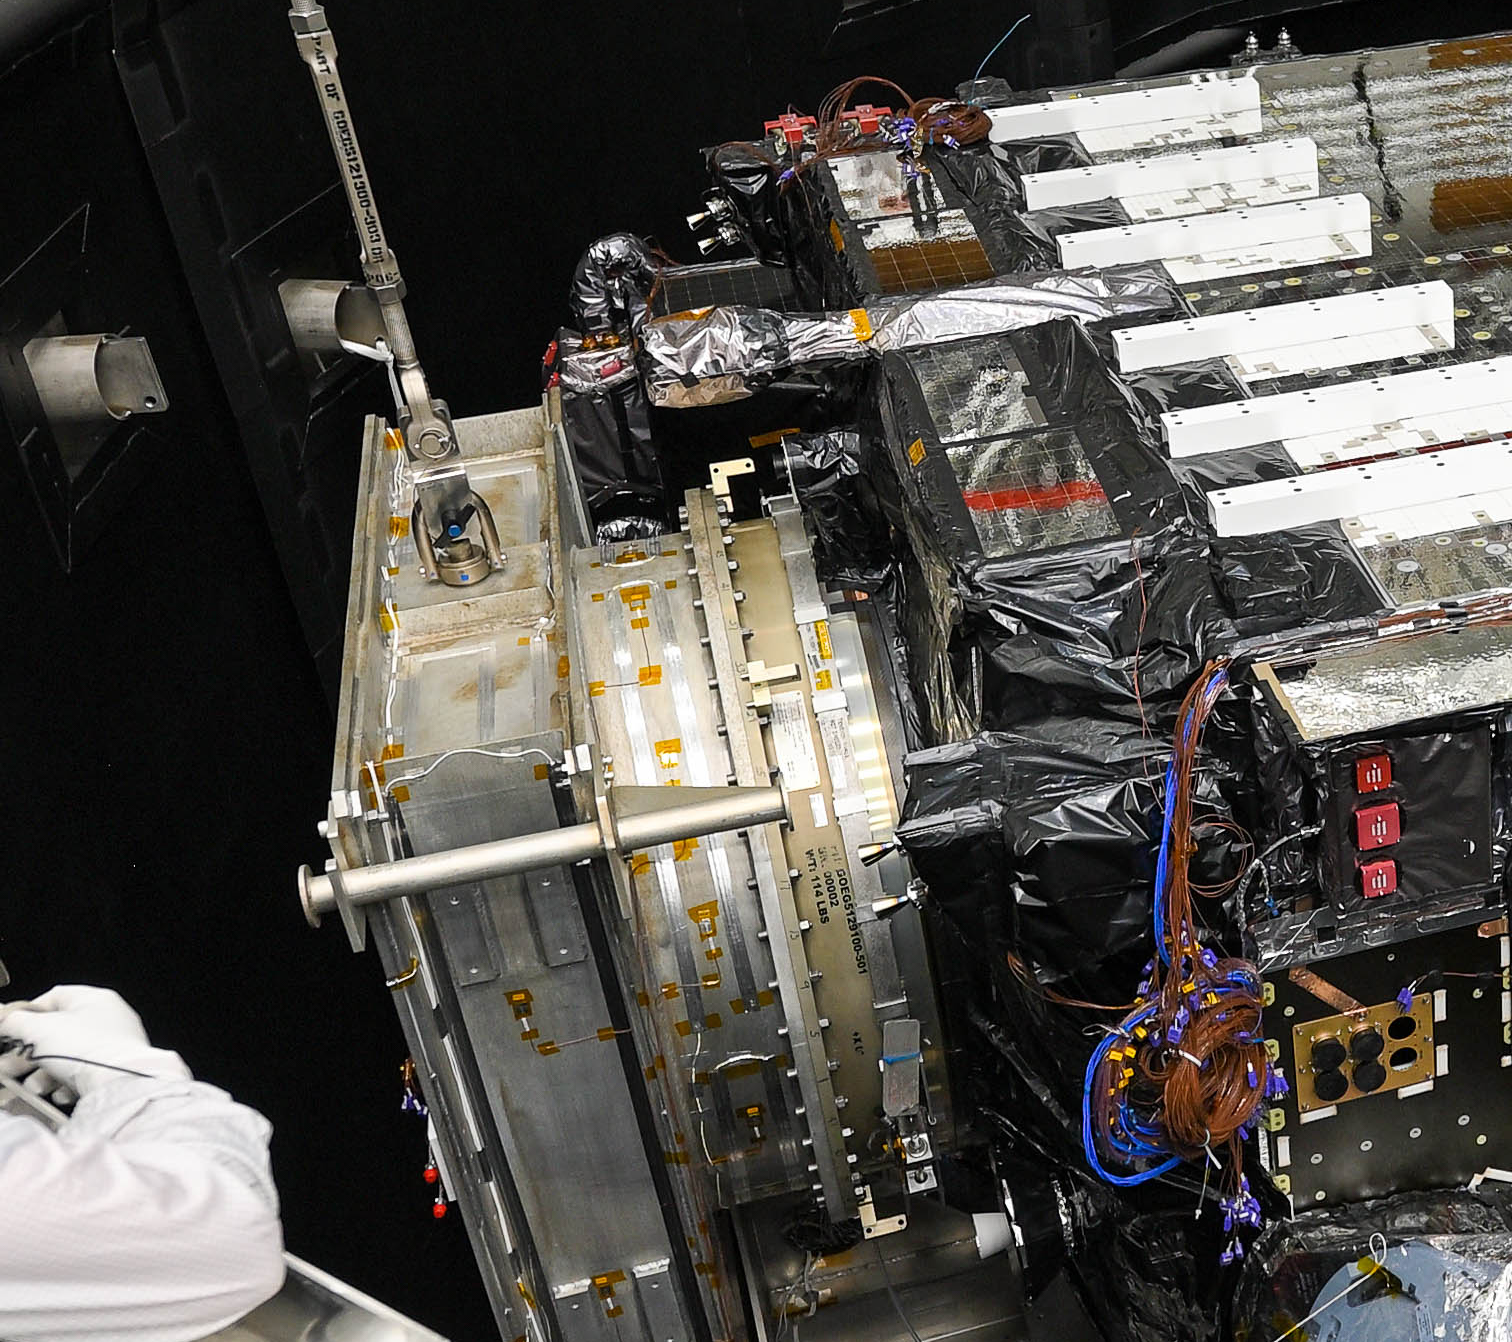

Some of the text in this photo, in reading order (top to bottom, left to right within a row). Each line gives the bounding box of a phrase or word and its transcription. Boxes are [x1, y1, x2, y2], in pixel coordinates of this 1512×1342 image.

[805, 849, 829, 924] WT: 114 LBS
